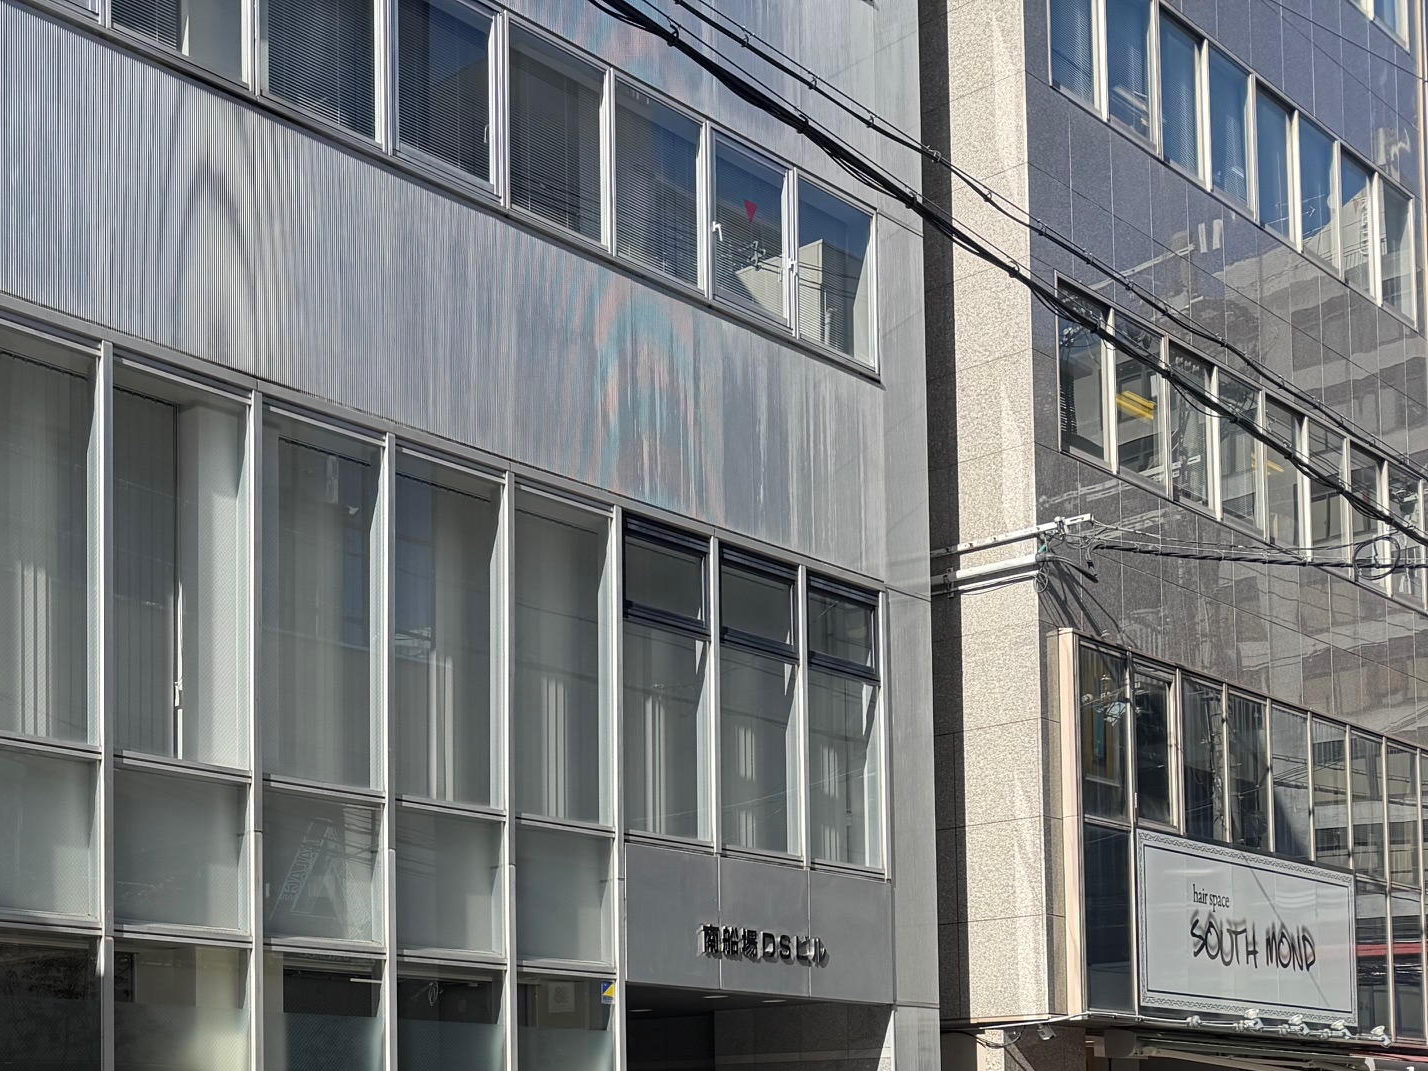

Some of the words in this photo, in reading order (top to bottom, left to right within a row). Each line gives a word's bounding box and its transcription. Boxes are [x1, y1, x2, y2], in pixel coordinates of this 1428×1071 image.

[1192, 883, 1208, 905] hair
[1209, 893, 1230, 912] space
[698, 924, 828, 964] 南船場DSビル
[1190, 914, 1259, 969] SOUTH
[1265, 924, 1316, 971] MOND
